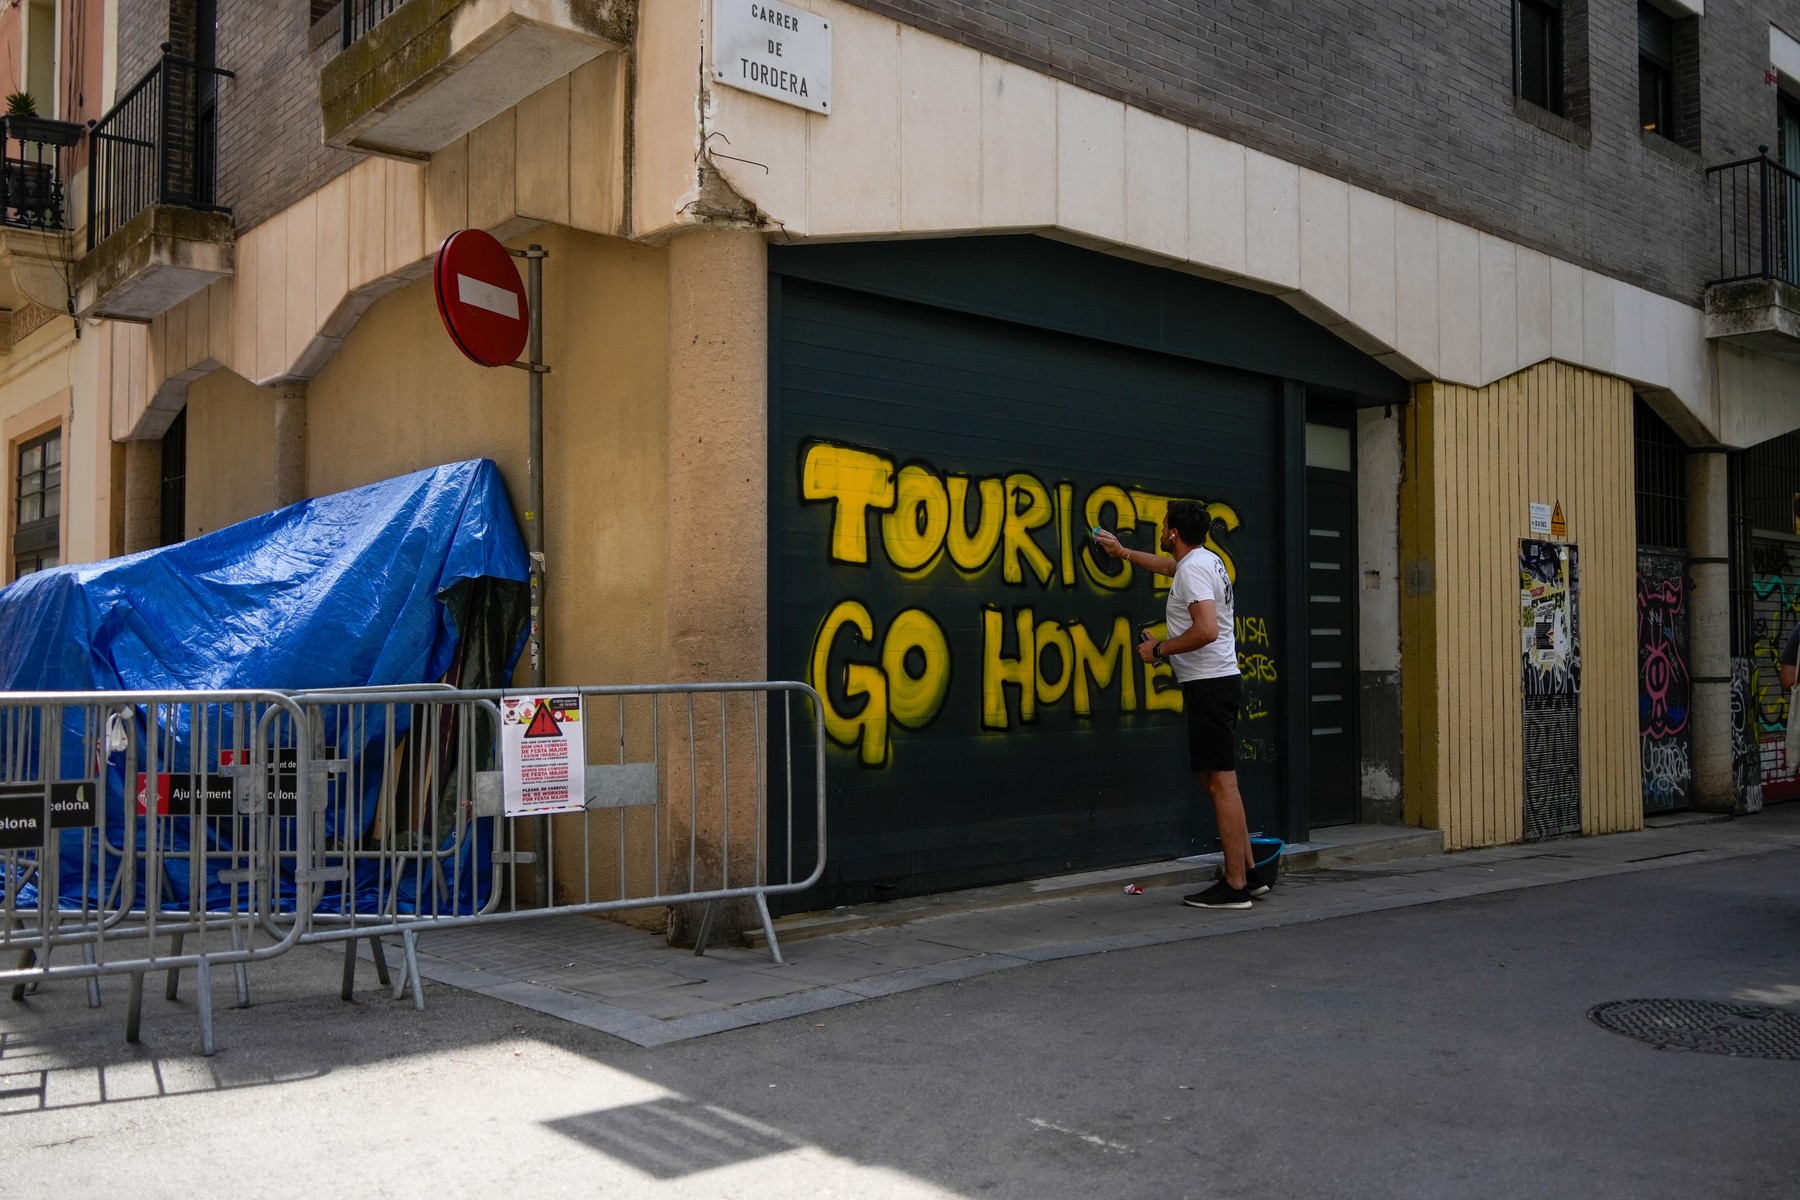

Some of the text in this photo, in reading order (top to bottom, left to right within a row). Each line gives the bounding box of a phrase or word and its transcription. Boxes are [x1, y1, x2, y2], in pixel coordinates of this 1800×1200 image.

[752, 4, 798, 32] CARRER
[768, 39, 782, 57] DE
[741, 58, 808, 97] TORDERA
[799, 438, 1244, 592] TOURISTS
[809, 597, 1185, 769] GO HOME
[173, 787, 231, 801] Ajutment
